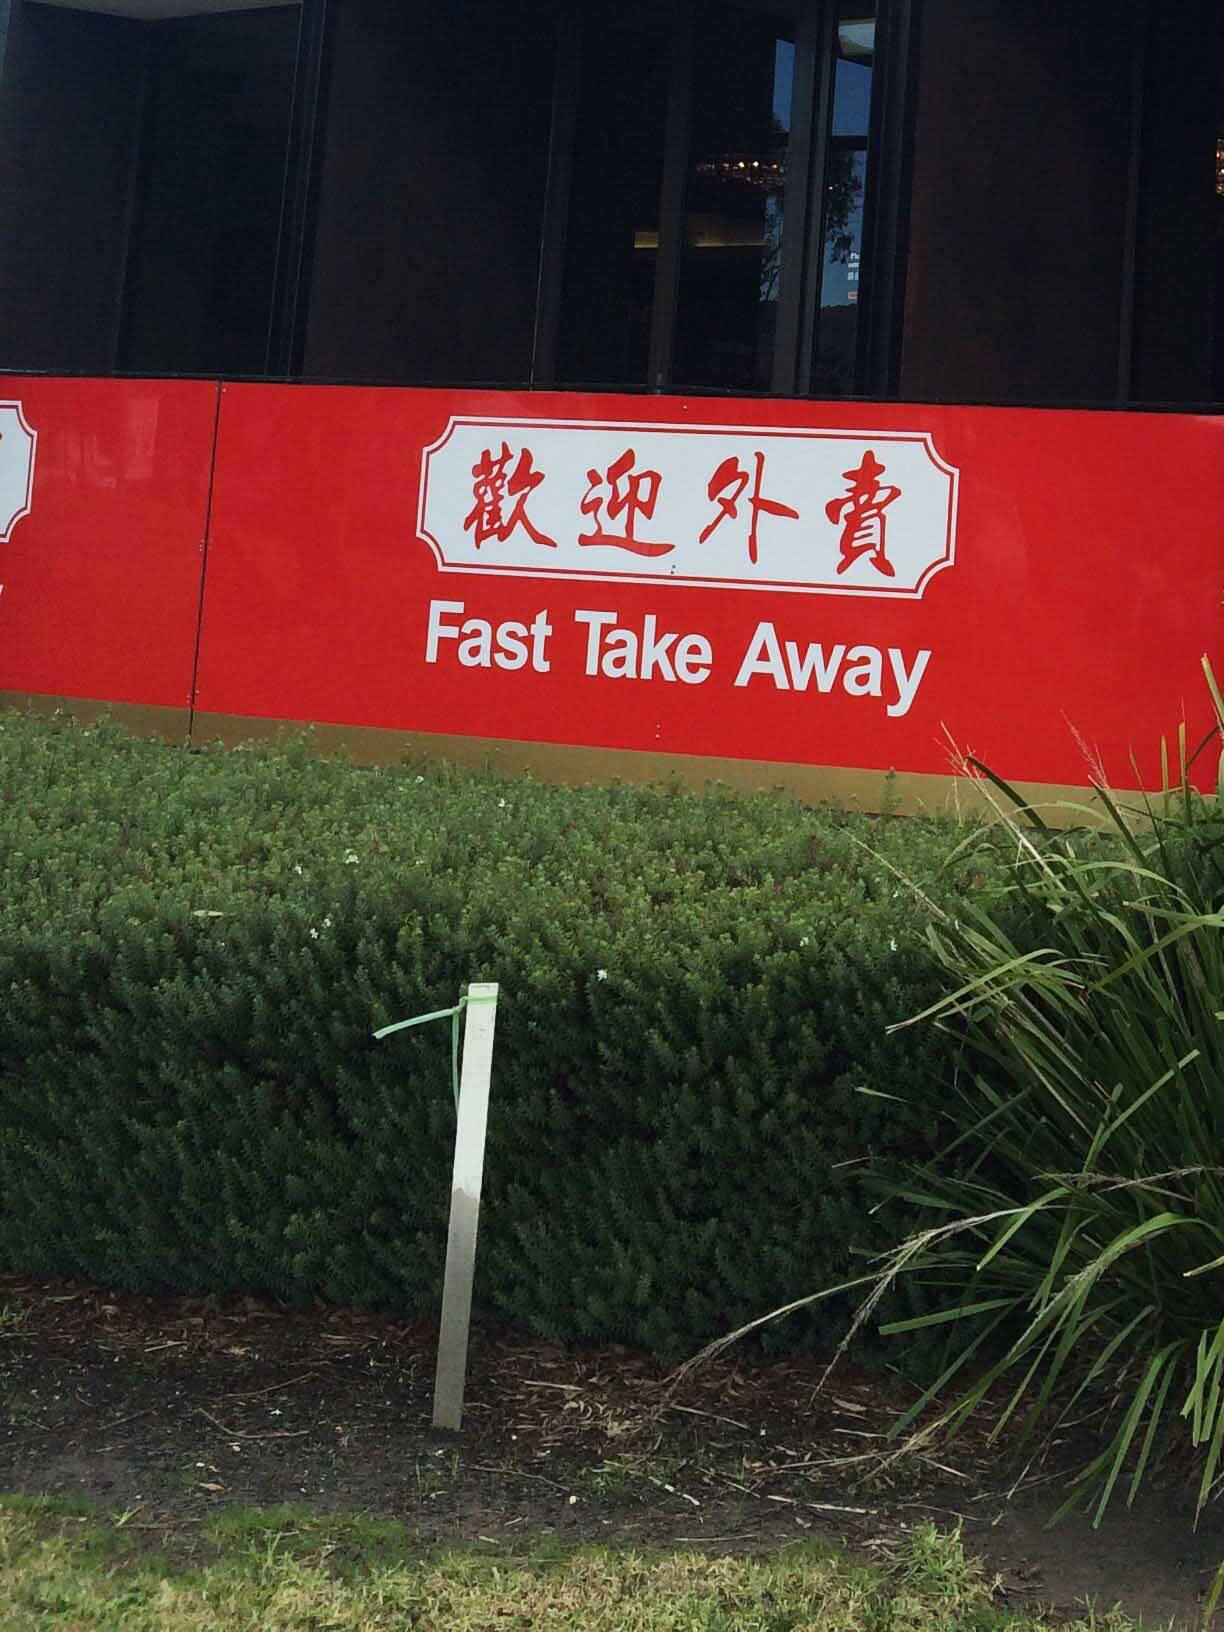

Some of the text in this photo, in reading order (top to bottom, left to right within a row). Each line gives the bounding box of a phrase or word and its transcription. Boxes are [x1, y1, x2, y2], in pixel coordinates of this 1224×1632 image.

[463, 440, 902, 578] 歡迎外賣
[425, 599, 931, 718] Fast Take Away
